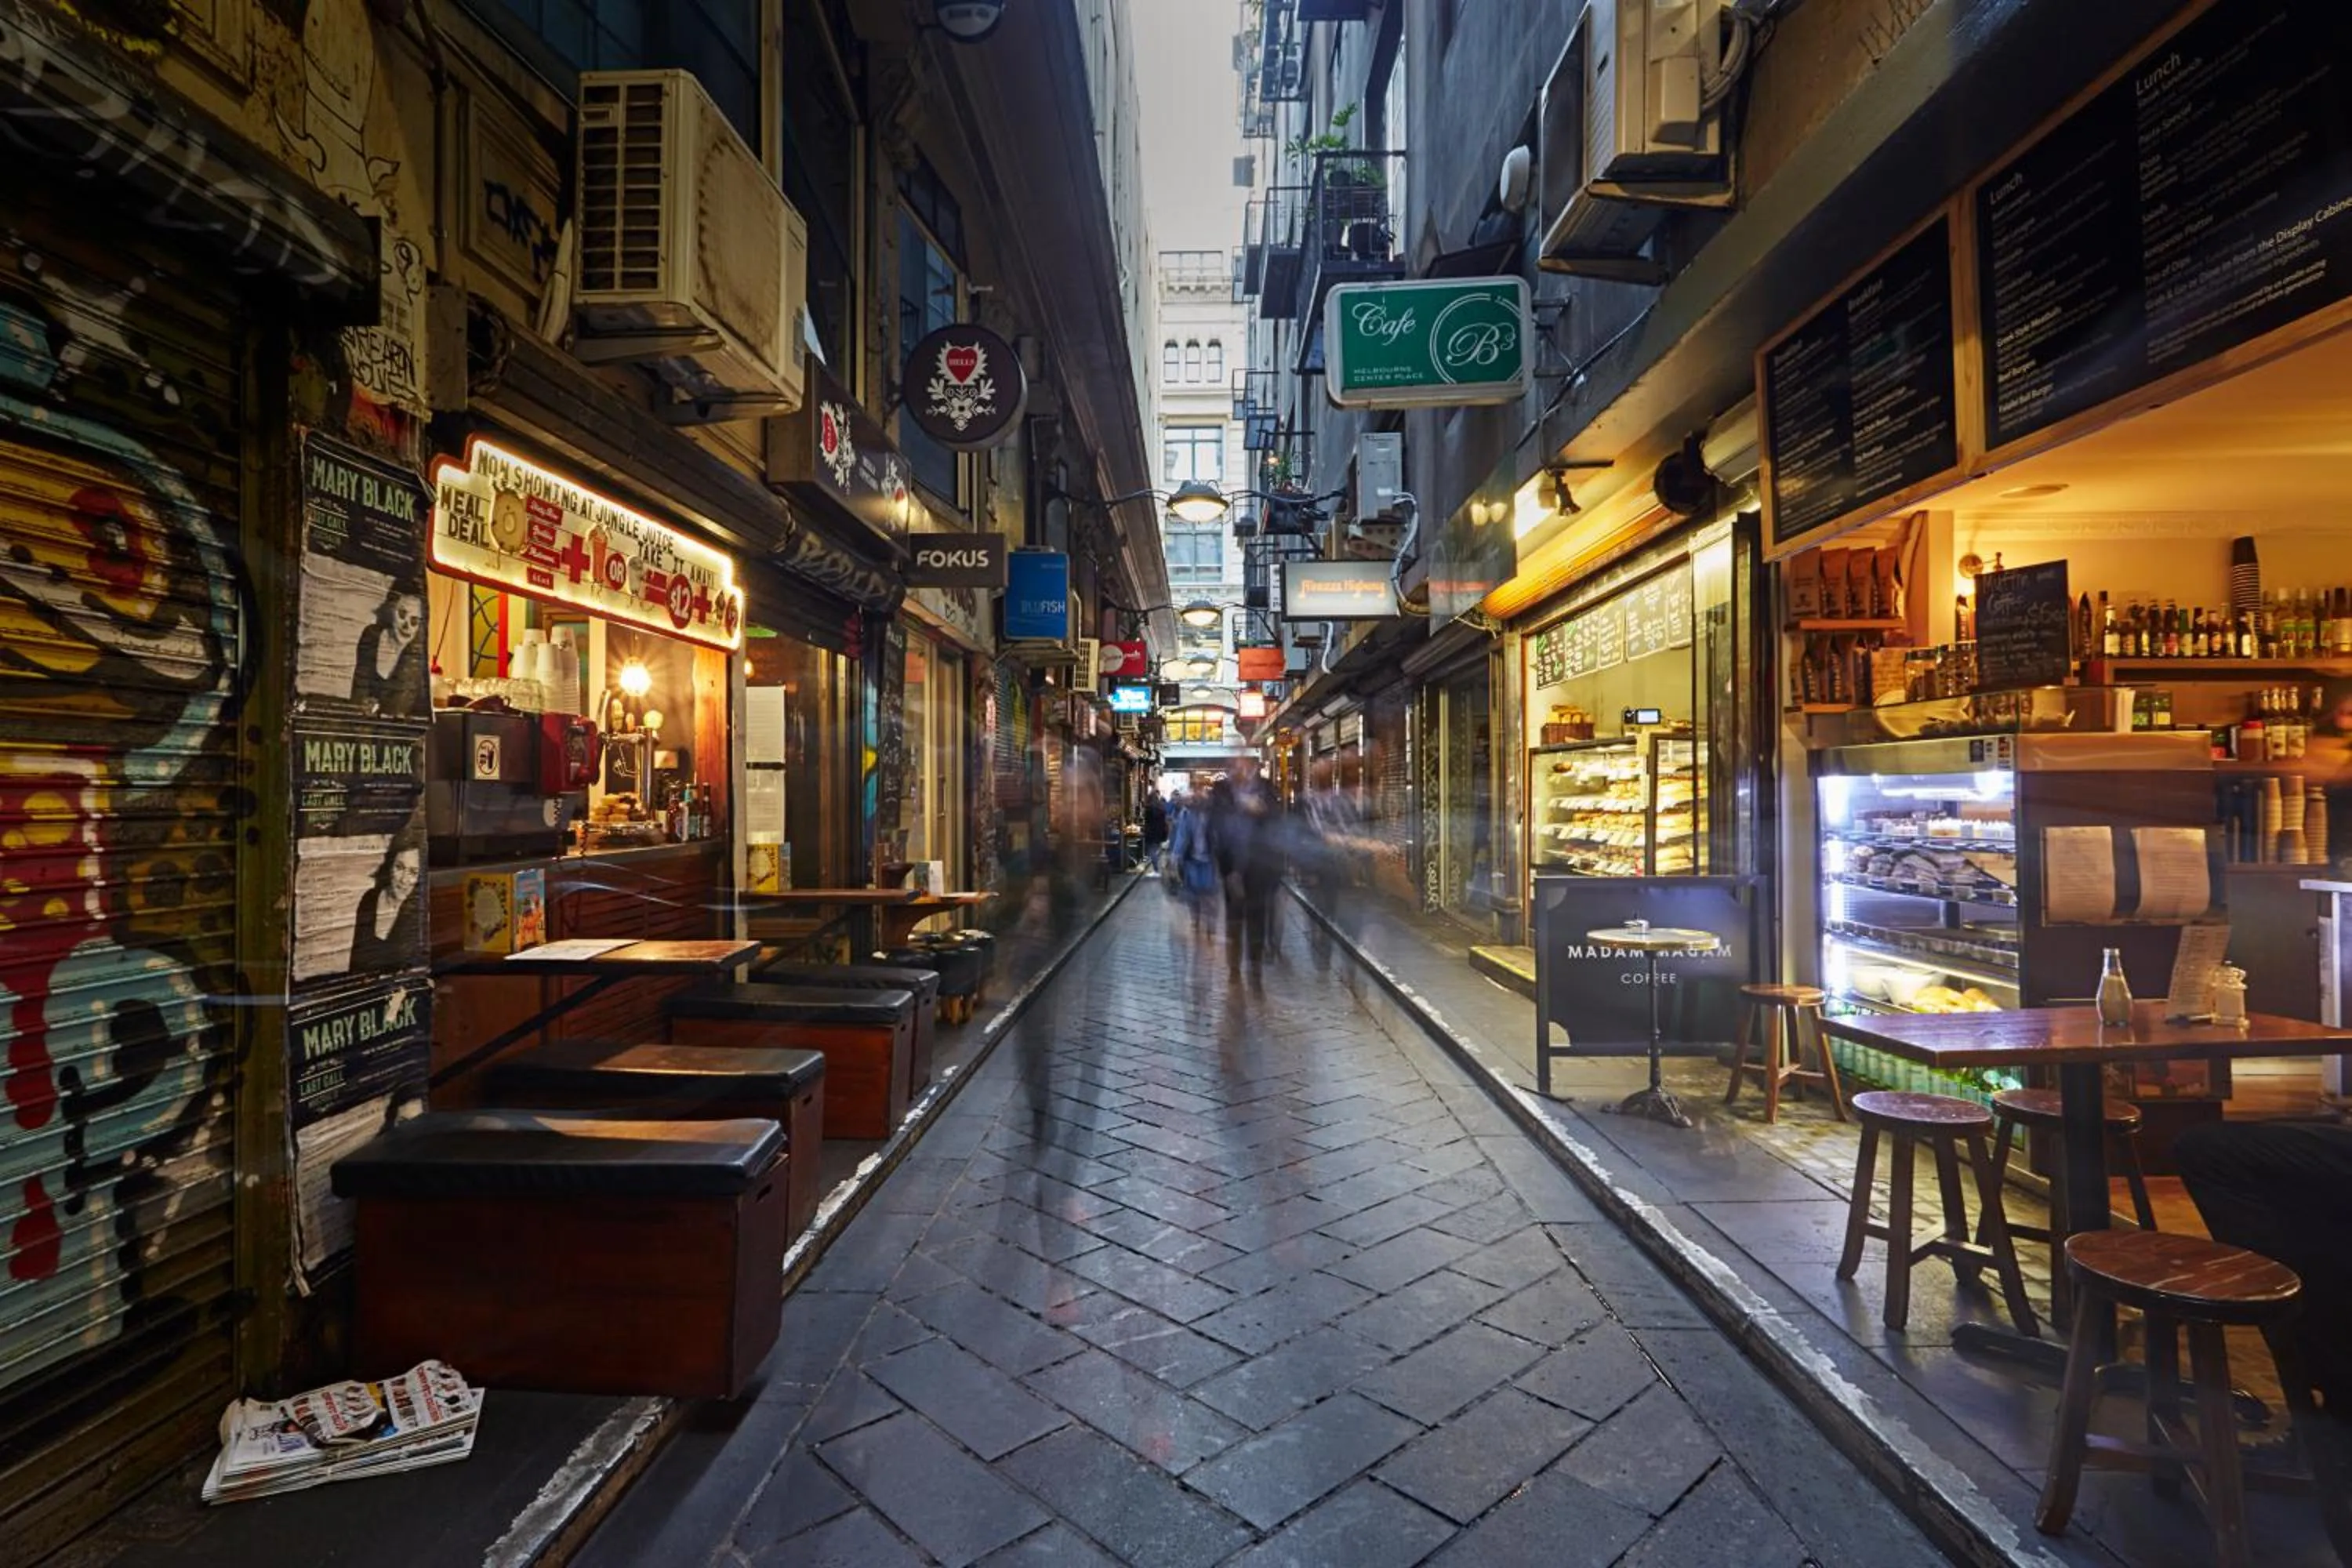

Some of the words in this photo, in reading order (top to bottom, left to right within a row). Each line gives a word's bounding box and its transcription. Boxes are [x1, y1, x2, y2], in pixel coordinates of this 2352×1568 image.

[2136, 51, 2181, 96] Lunch
[1989, 172, 2024, 206] Lunch
[2257, 237, 2274, 252] the
[2275, 217, 2314, 243] Display
[1352, 301, 1417, 346] Cafe
[311, 456, 360, 502] MARY
[362, 477, 416, 522] BLACK
[441, 485, 485, 521] MEAL
[448, 512, 490, 548] DEAL
[580, 497, 595, 519] AT
[596, 504, 641, 539] JUNGLE
[642, 524, 674, 554] JUICE
[637, 540, 662, 567] TAKE
[916, 550, 989, 568] FOKUS
[609, 559, 624, 584] OR
[670, 585, 691, 619] $12
[304, 740, 355, 773] MARY
[360, 744, 413, 775] BLACK
[1568, 945, 1645, 959] MADAM
[1621, 973, 1677, 984] COFFEE
[302, 1014, 355, 1062] MARY
